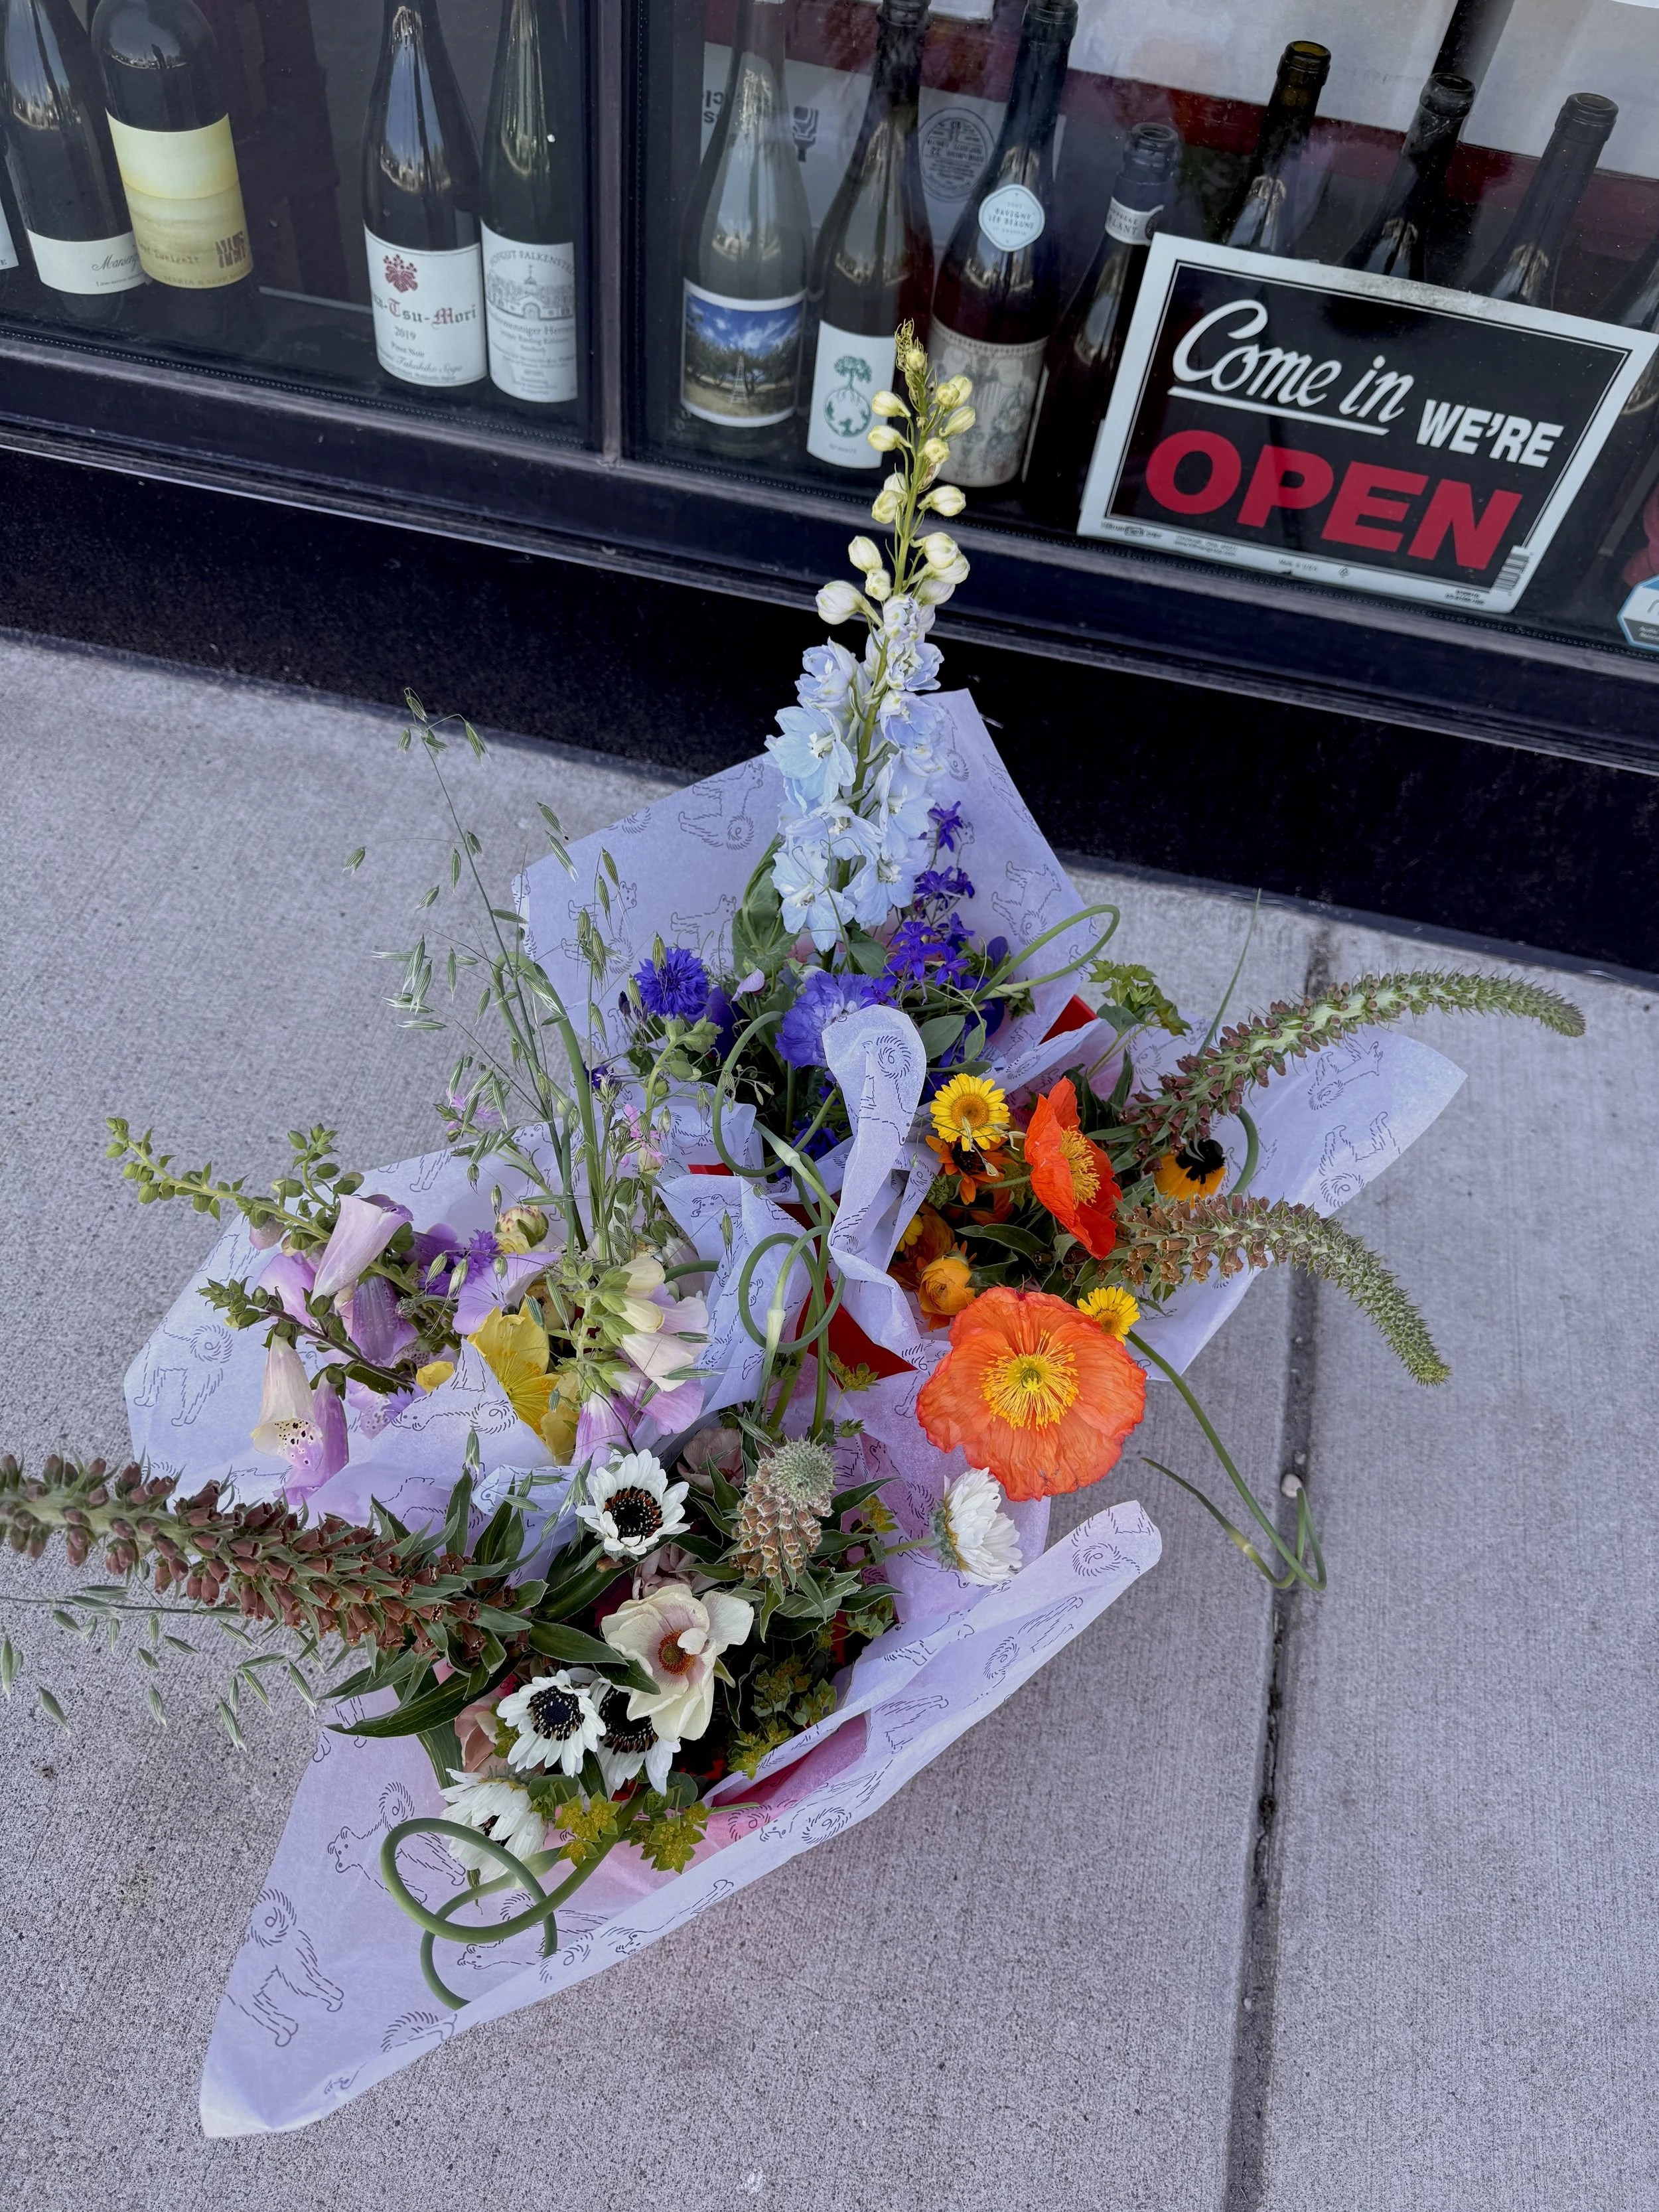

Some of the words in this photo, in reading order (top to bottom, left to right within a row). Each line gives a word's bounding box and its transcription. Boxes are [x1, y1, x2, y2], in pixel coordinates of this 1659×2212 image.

[1173, 299, 1341, 407] Come
[1339, 356, 1414, 422] in
[1416, 400, 1564, 468] WE'RE
[1145, 430, 1522, 570] OPEN
